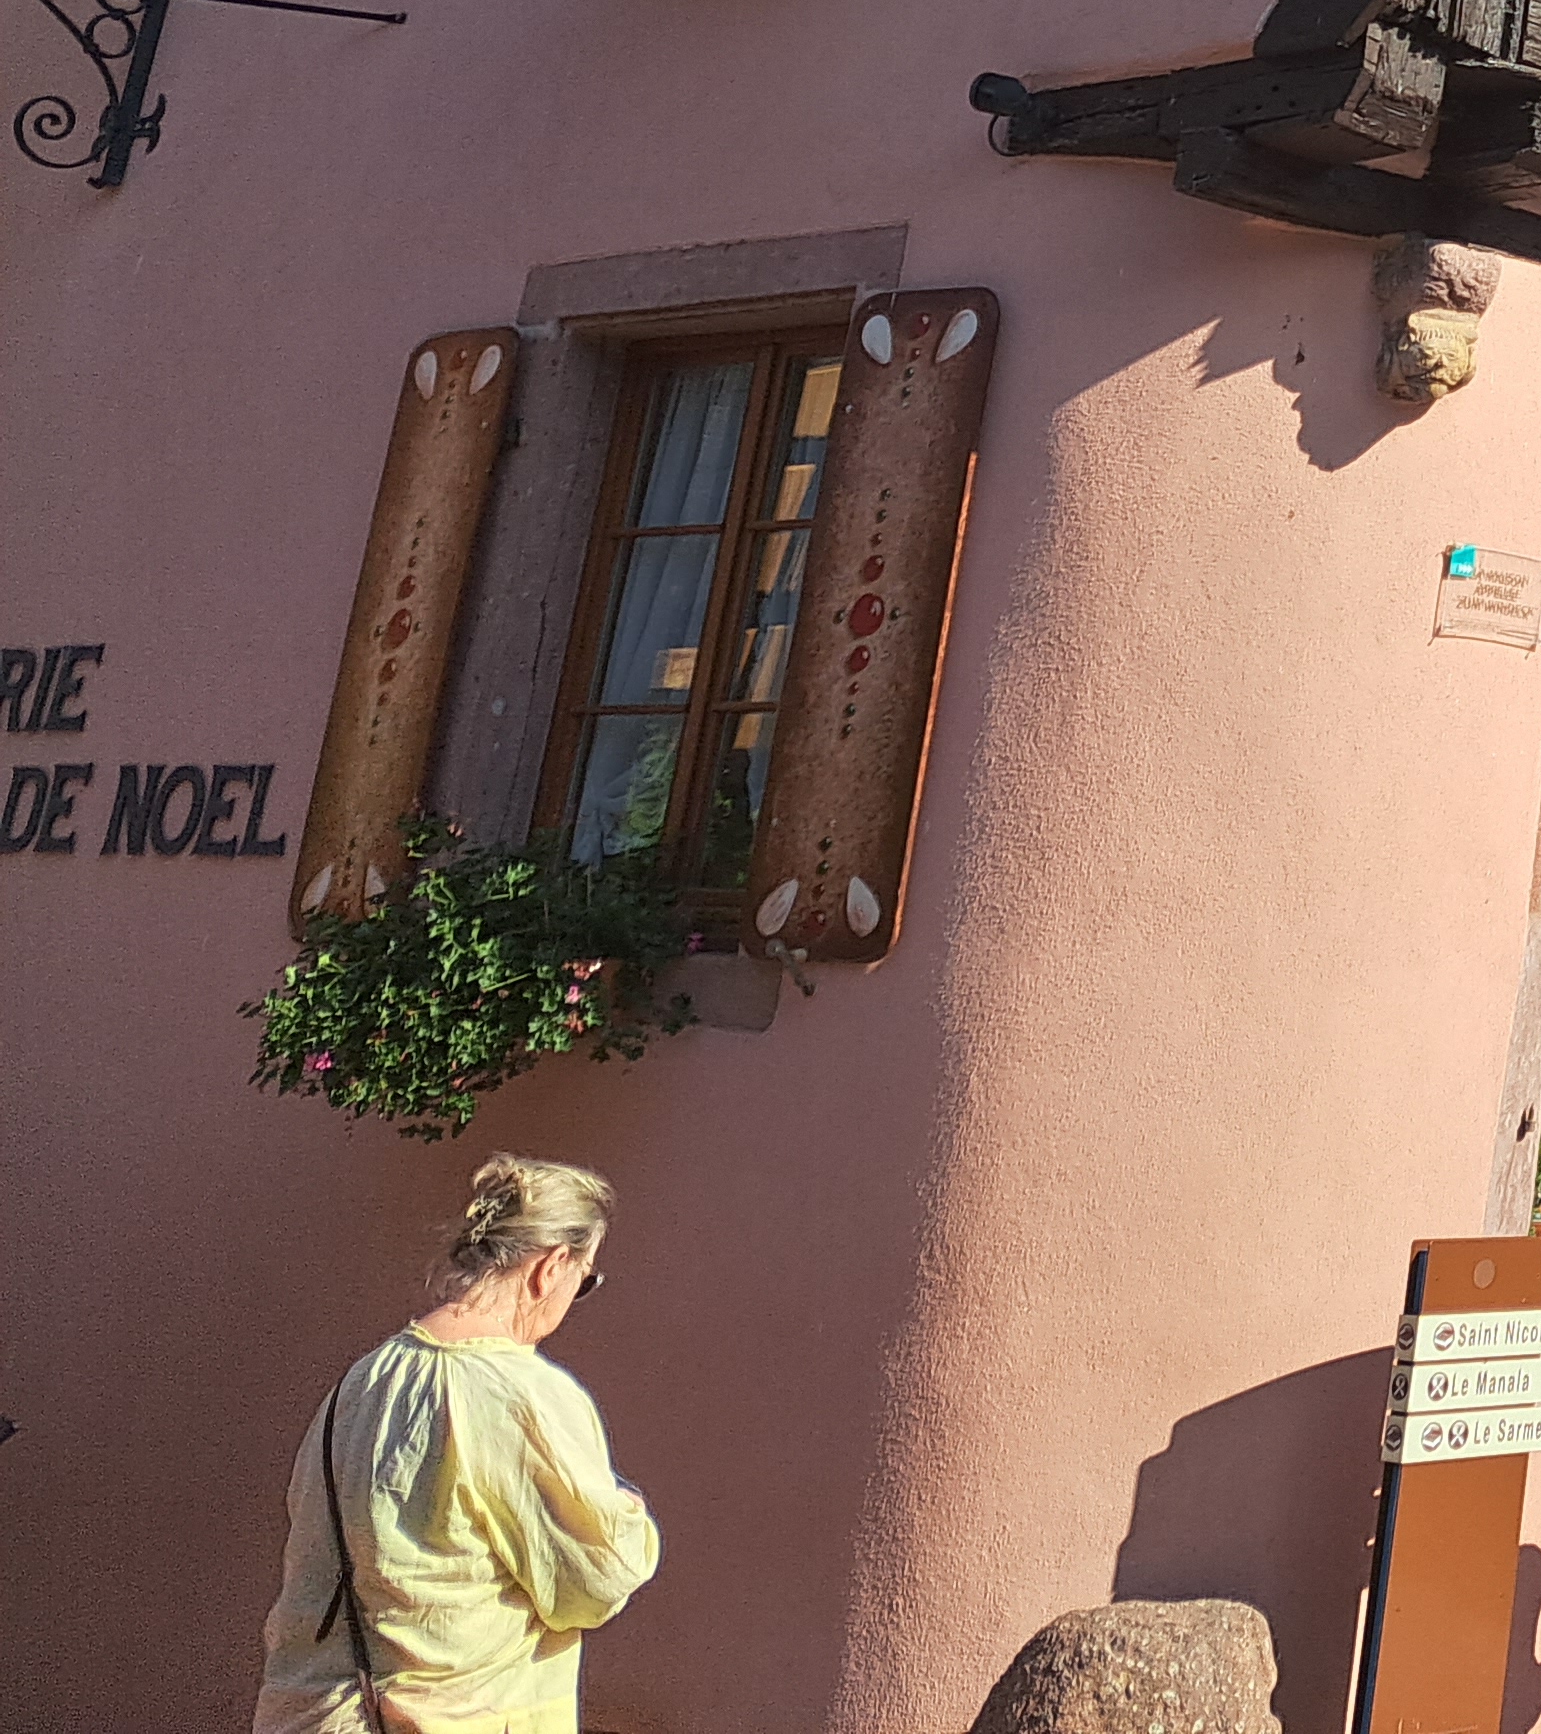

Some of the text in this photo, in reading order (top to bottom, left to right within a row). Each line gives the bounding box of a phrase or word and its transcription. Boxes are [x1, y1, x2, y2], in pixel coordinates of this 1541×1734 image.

[0, 762, 286, 857] DE NOEL
[1458, 1322, 1499, 1347] Saint
[1451, 1369, 1530, 1397] Le Manala
[1473, 1421, 1490, 1445] Le
